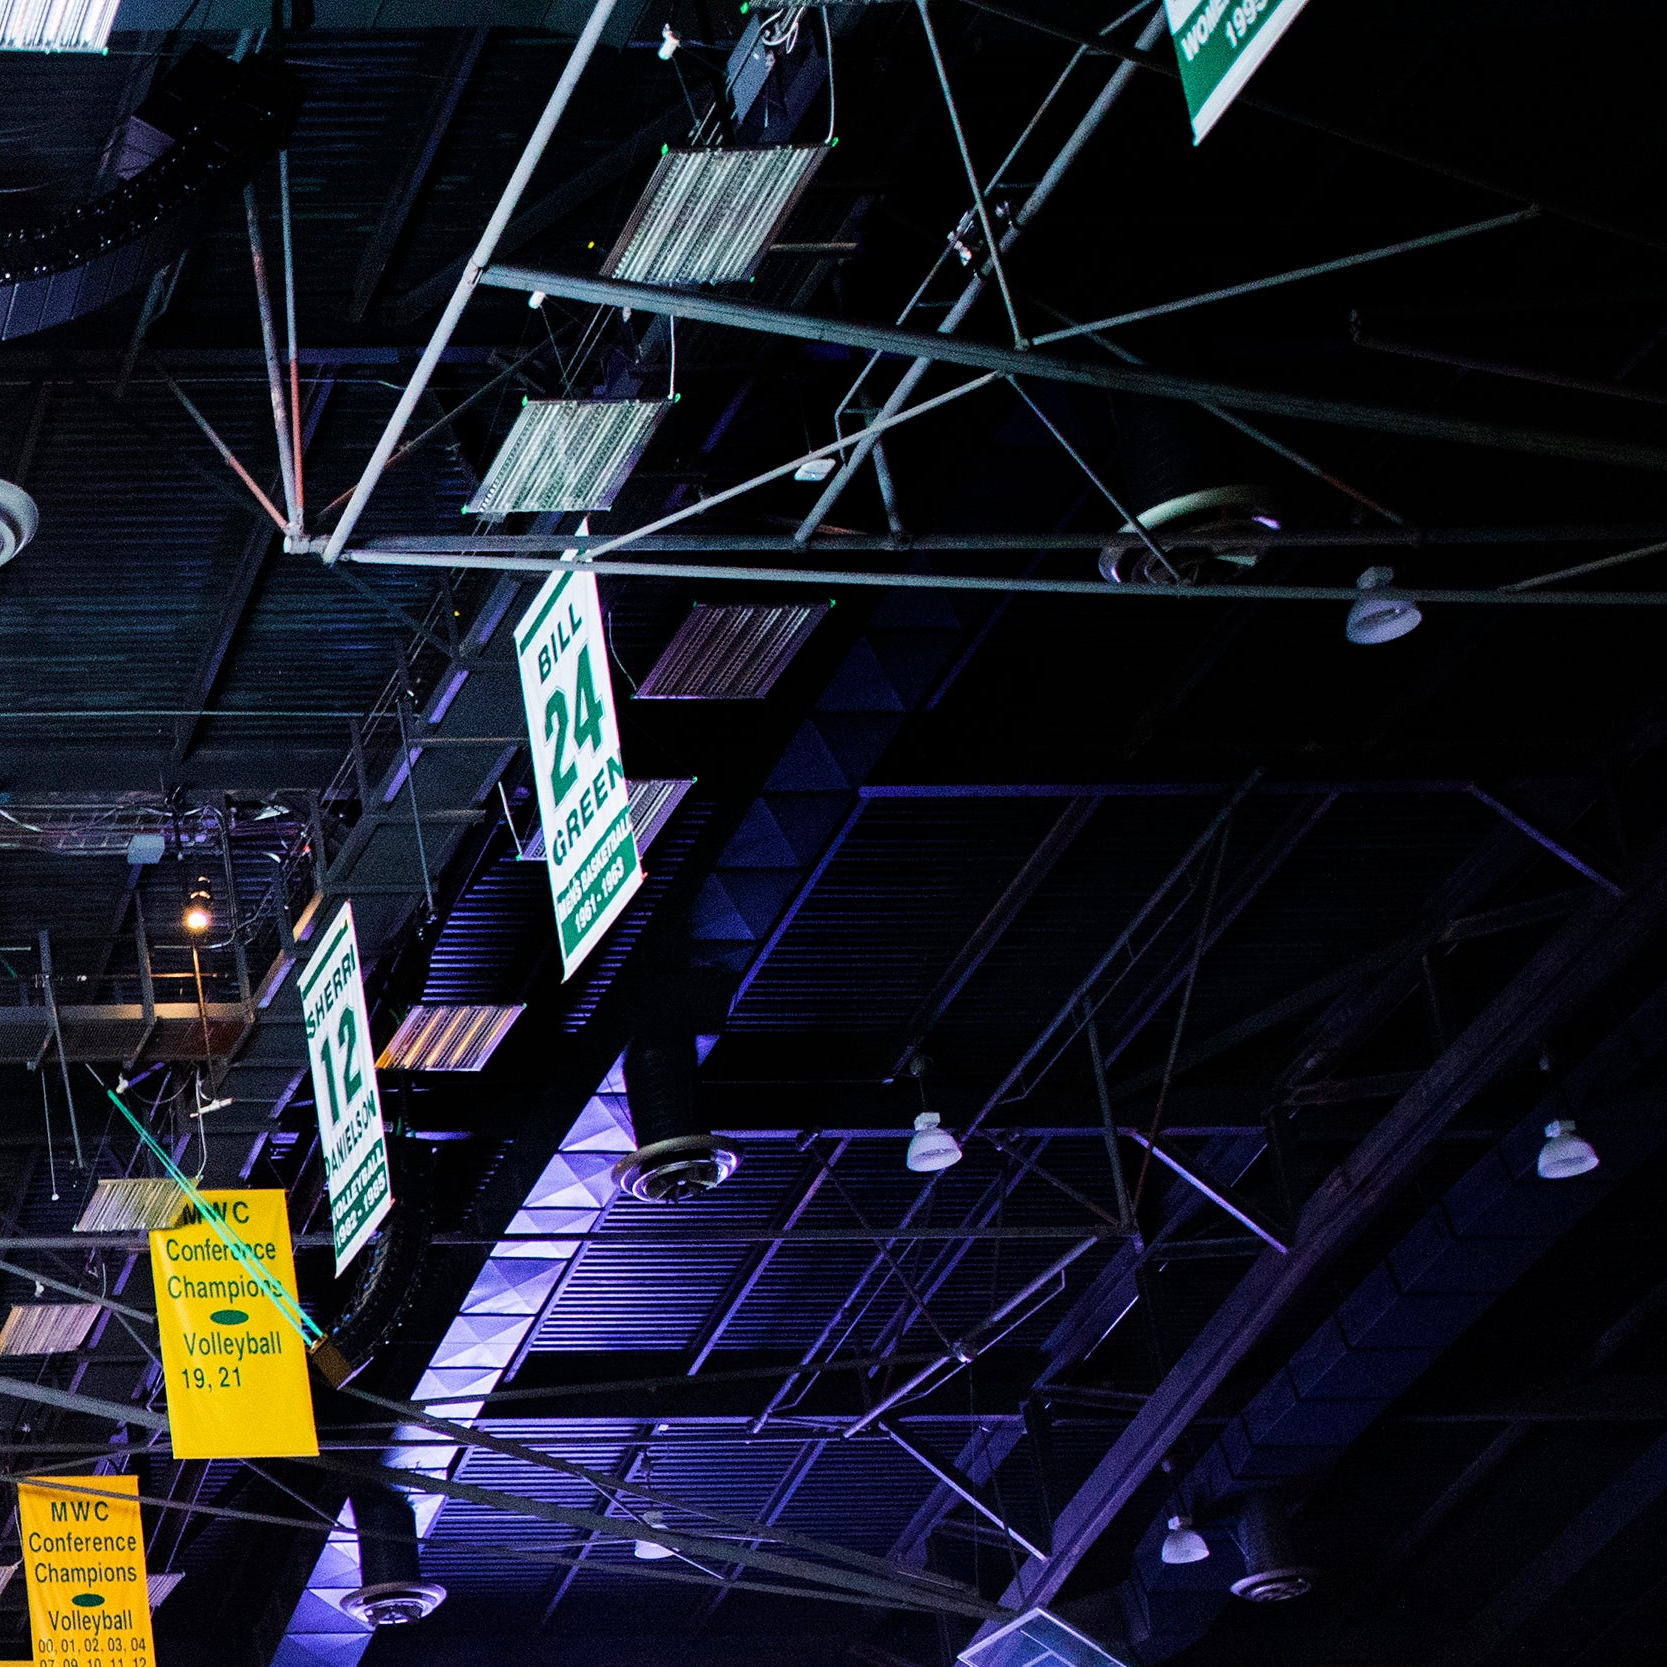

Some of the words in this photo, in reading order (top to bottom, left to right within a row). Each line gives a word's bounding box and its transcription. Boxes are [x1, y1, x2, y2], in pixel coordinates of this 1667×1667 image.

[537, 603, 582, 685] BILL
[545, 643, 604, 808] 24
[552, 756, 624, 866] GREEN
[556, 876, 582, 925] MEN'S
[579, 811, 632, 893] BASKETBALL
[574, 893, 597, 933] 1961
[602, 856, 625, 898] 1963
[306, 944, 357, 1039] SHERRI
[321, 1006, 363, 1126] 12
[324, 1090, 377, 1177] DANIELSON
[332, 1147, 384, 1226] VOLLEYBALL
[183, 1200, 250, 1226] MWC
[166, 1238, 276, 1262] Conference
[168, 1275, 283, 1303] Champions
[183, 1331, 282, 1361] Volleyball
[181, 1367, 213, 1393] 19,
[218, 1366, 241, 1388] 21
[51, 1501, 109, 1523] MWC
[28, 1532, 137, 1554] Conference
[34, 1562, 137, 1587] Champions
[48, 1609, 133, 1638] Volleyball
[38, 1638, 57, 1655] 00,
[60, 1638, 81, 1655] 01,
[84, 1637, 104, 1654] 02,
[130, 1637, 146, 1652] 04
